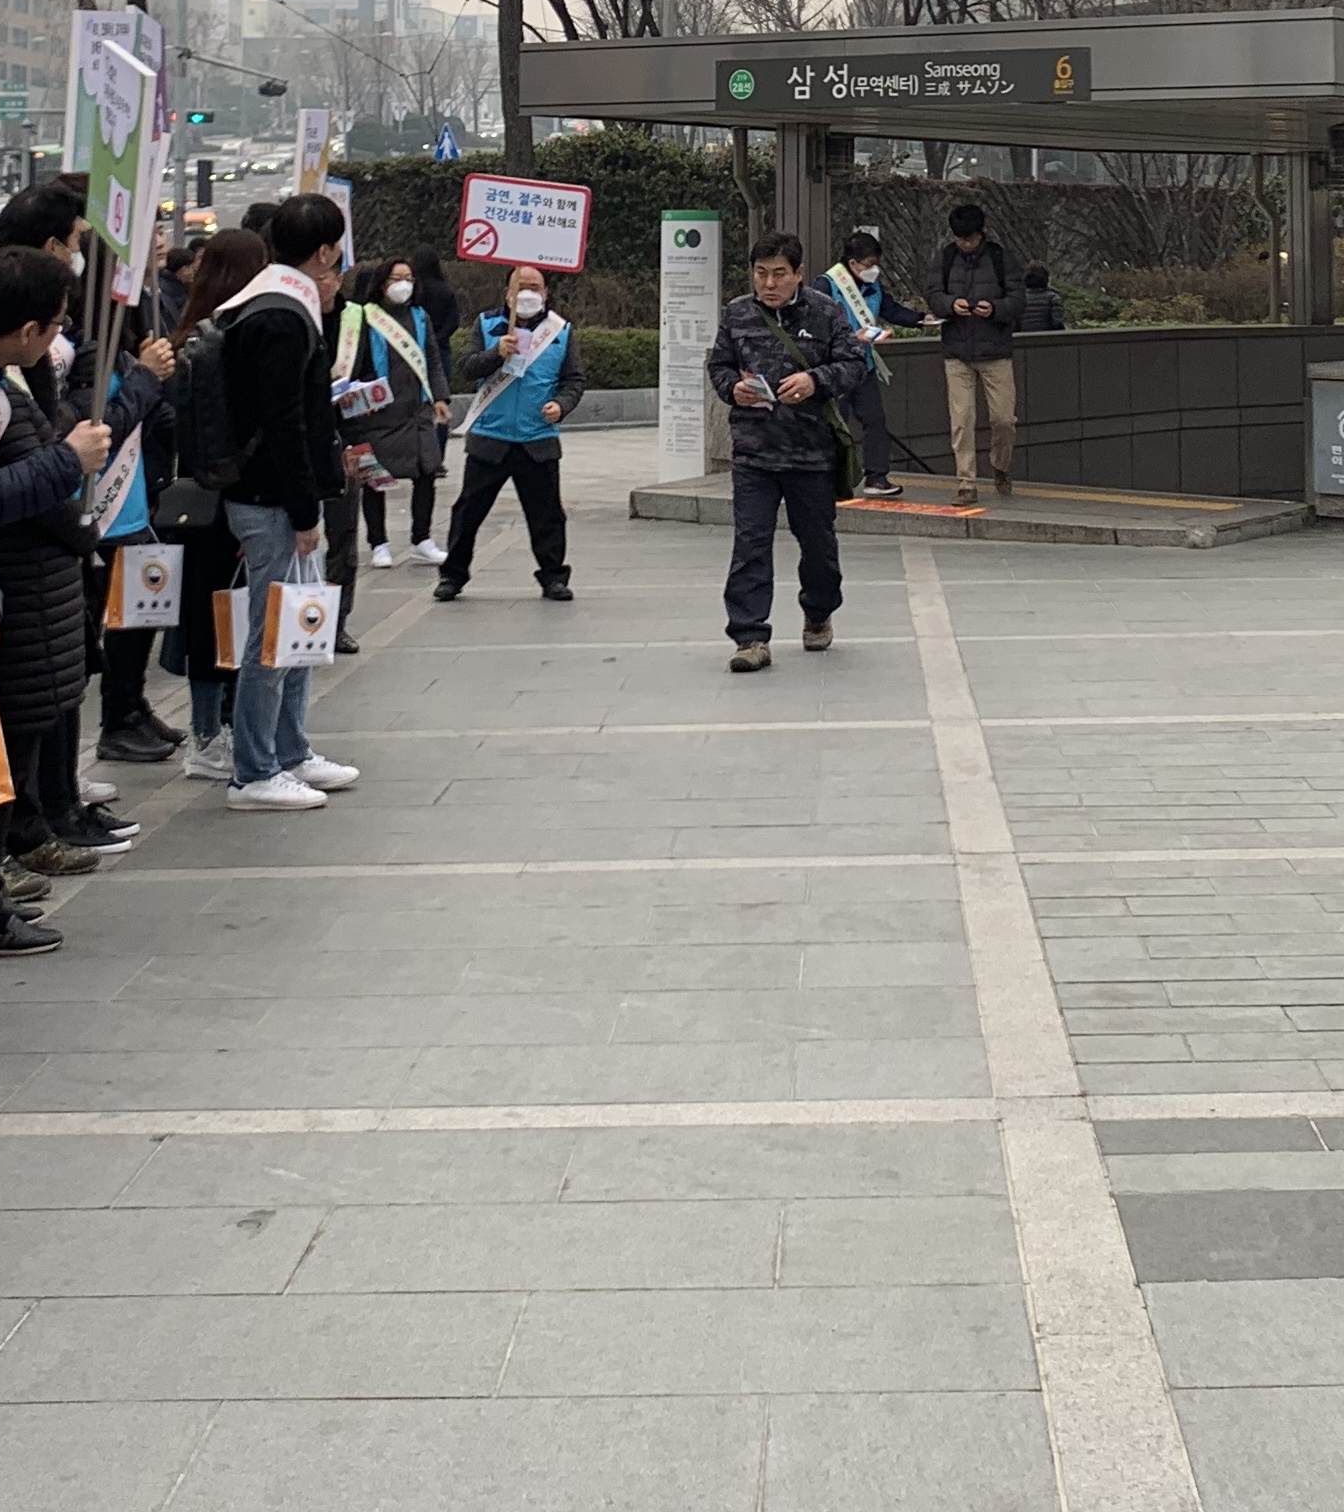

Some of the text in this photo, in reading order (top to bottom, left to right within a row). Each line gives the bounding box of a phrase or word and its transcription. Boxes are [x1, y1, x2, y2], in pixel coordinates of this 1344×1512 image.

[924, 61, 1001, 79] Samseong
[1056, 55, 1072, 78] 6
[924, 80, 1016, 96] 三成 サムソン
[485, 188, 577, 211] 금연, 절주와 함께
[484, 206, 577, 228] 건강생활 실천해요
